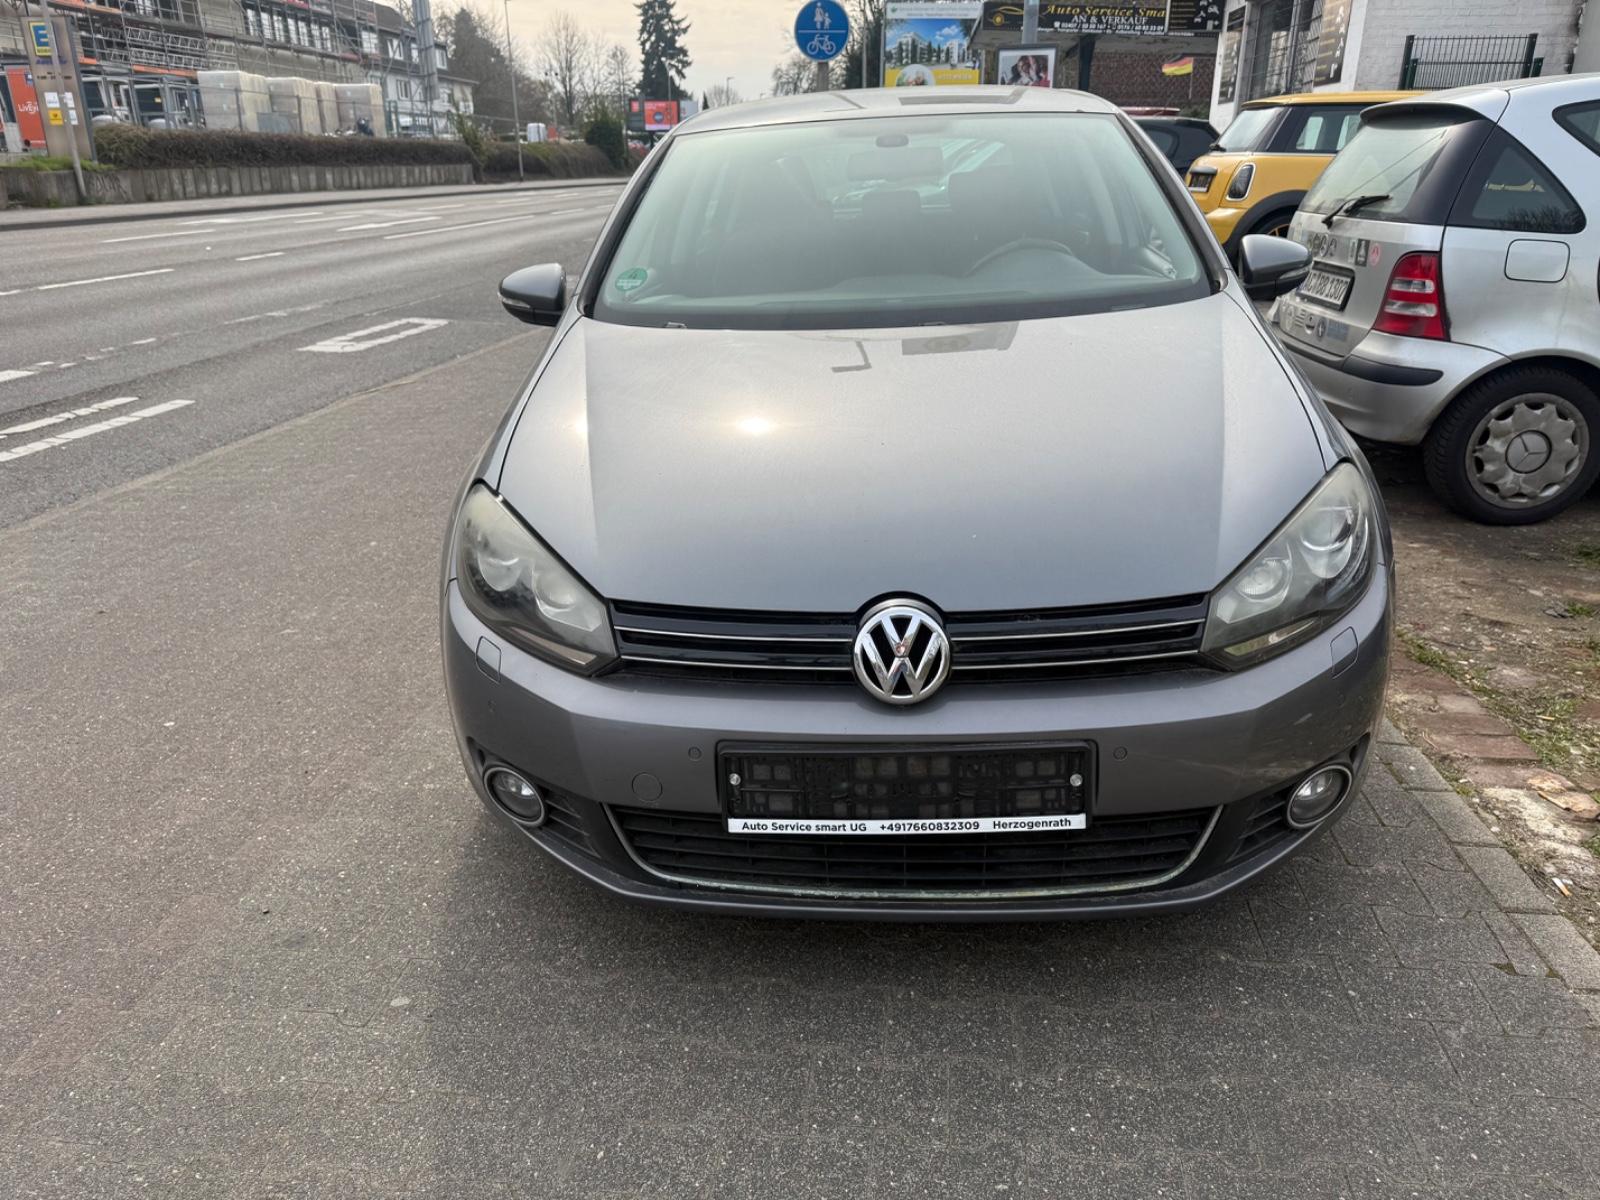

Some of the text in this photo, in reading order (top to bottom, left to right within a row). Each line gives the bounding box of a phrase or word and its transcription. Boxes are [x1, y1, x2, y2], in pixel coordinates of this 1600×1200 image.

[1045, 5, 1080, 15] Auto
[1085, 6, 1134, 17] Service
[1071, 14, 1087, 23] AN
[1101, 15, 1149, 25] VERKAUF
[742, 818, 1071, 832] Auto Service smart UG +4917660832309 Herzogenrath
